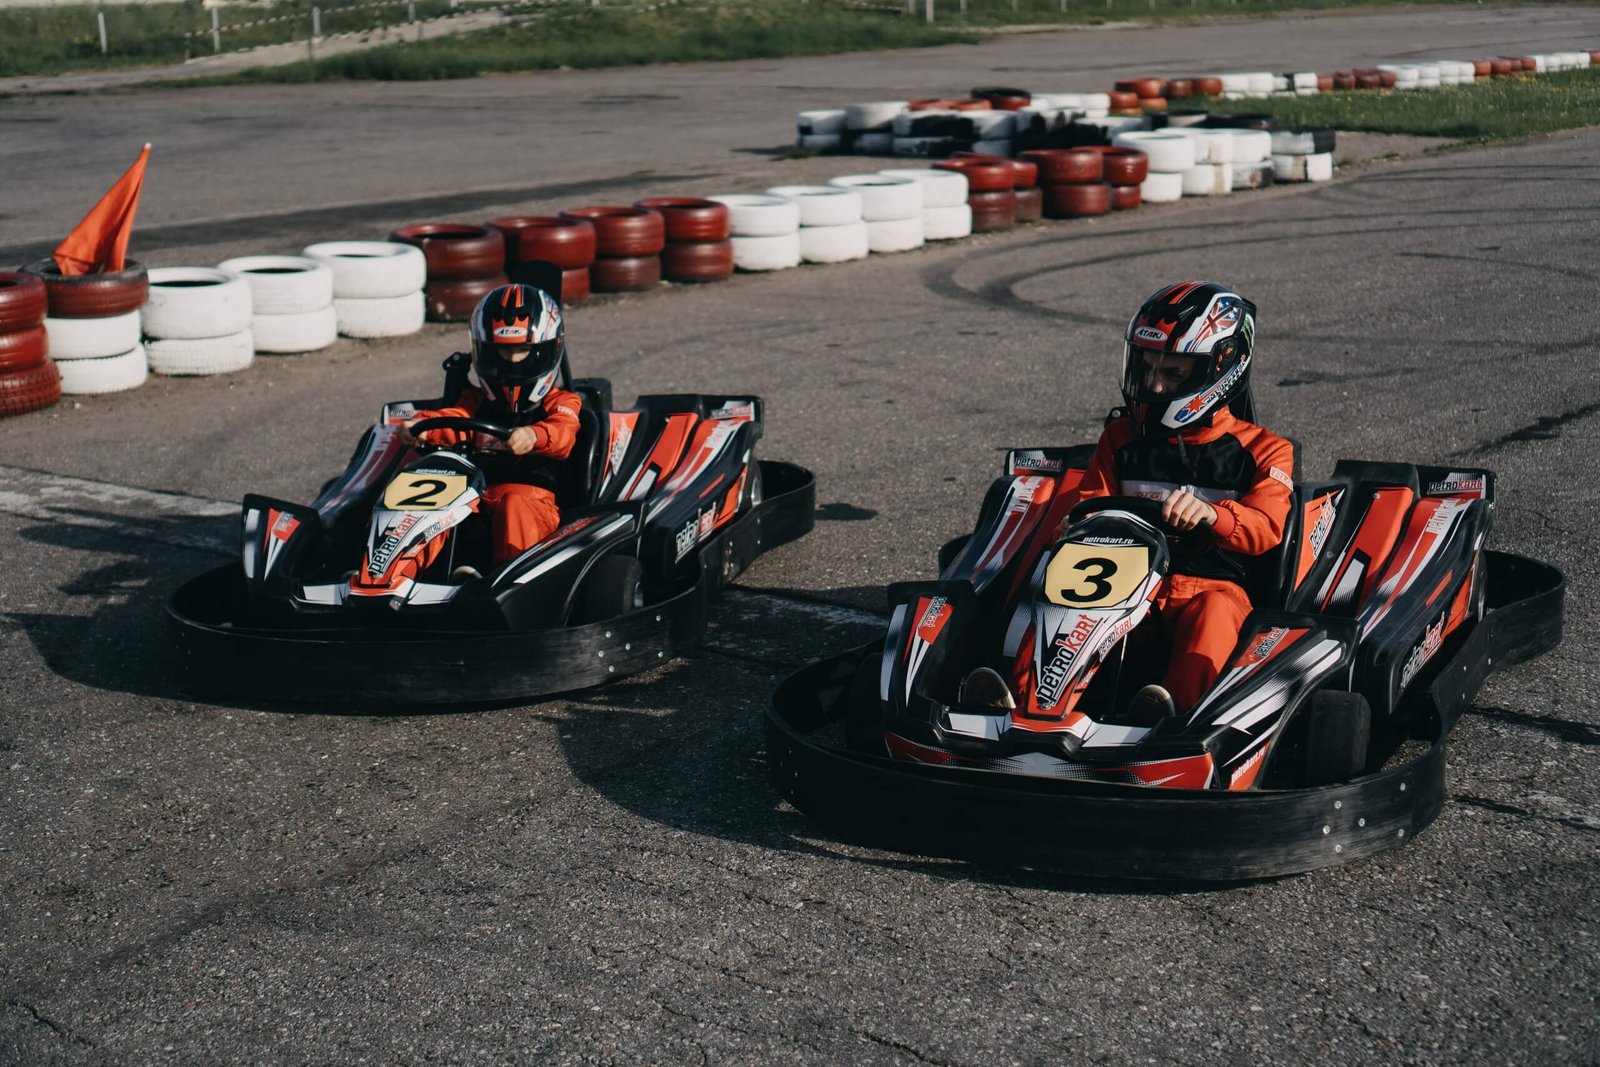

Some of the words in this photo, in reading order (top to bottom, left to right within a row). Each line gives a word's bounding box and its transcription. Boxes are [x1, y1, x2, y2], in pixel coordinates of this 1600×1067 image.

[1136, 328, 1163, 340] ATAKI
[396, 479, 447, 506] 2
[1082, 535, 1134, 544] petrokart.ru
[1061, 558, 1117, 602] 3
